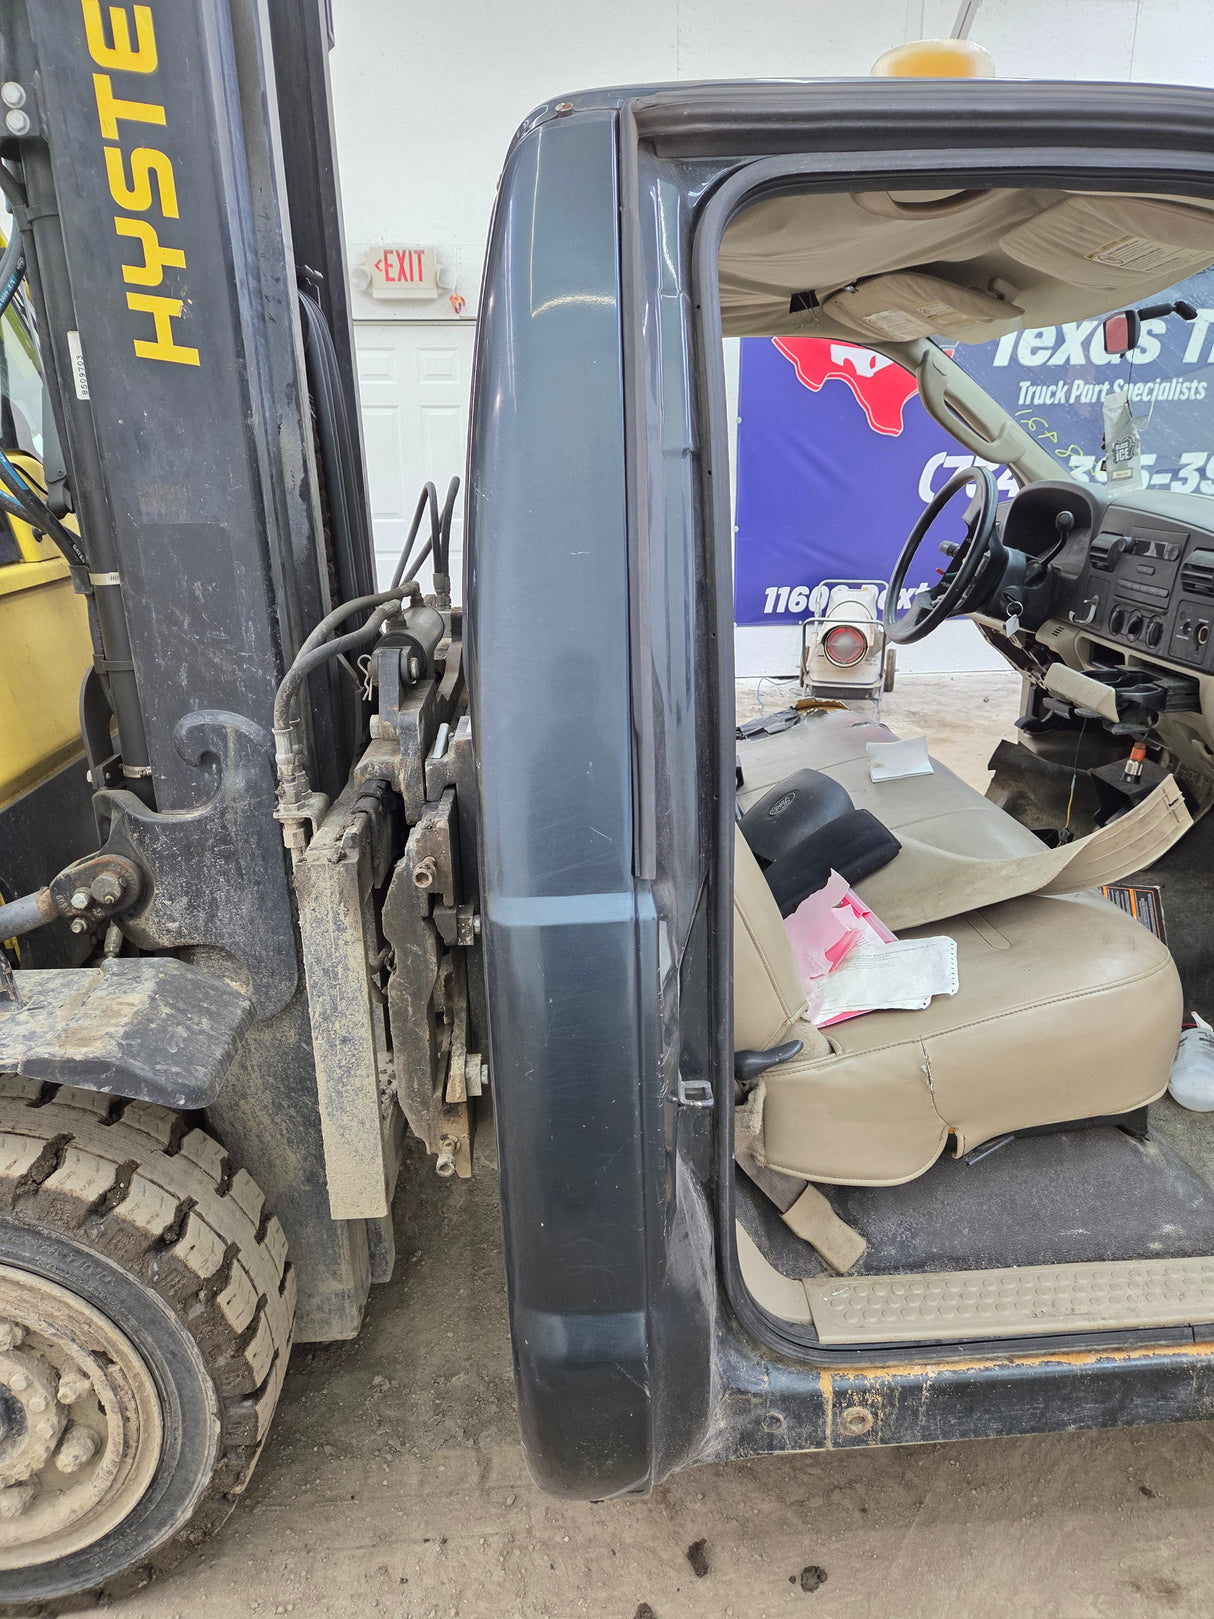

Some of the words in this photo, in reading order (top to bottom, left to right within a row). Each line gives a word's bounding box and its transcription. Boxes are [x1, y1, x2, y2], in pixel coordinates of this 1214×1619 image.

[384, 249, 425, 283] EXIT
[1018, 380, 1068, 405] Truck
[1069, 378, 1110, 404] Part
